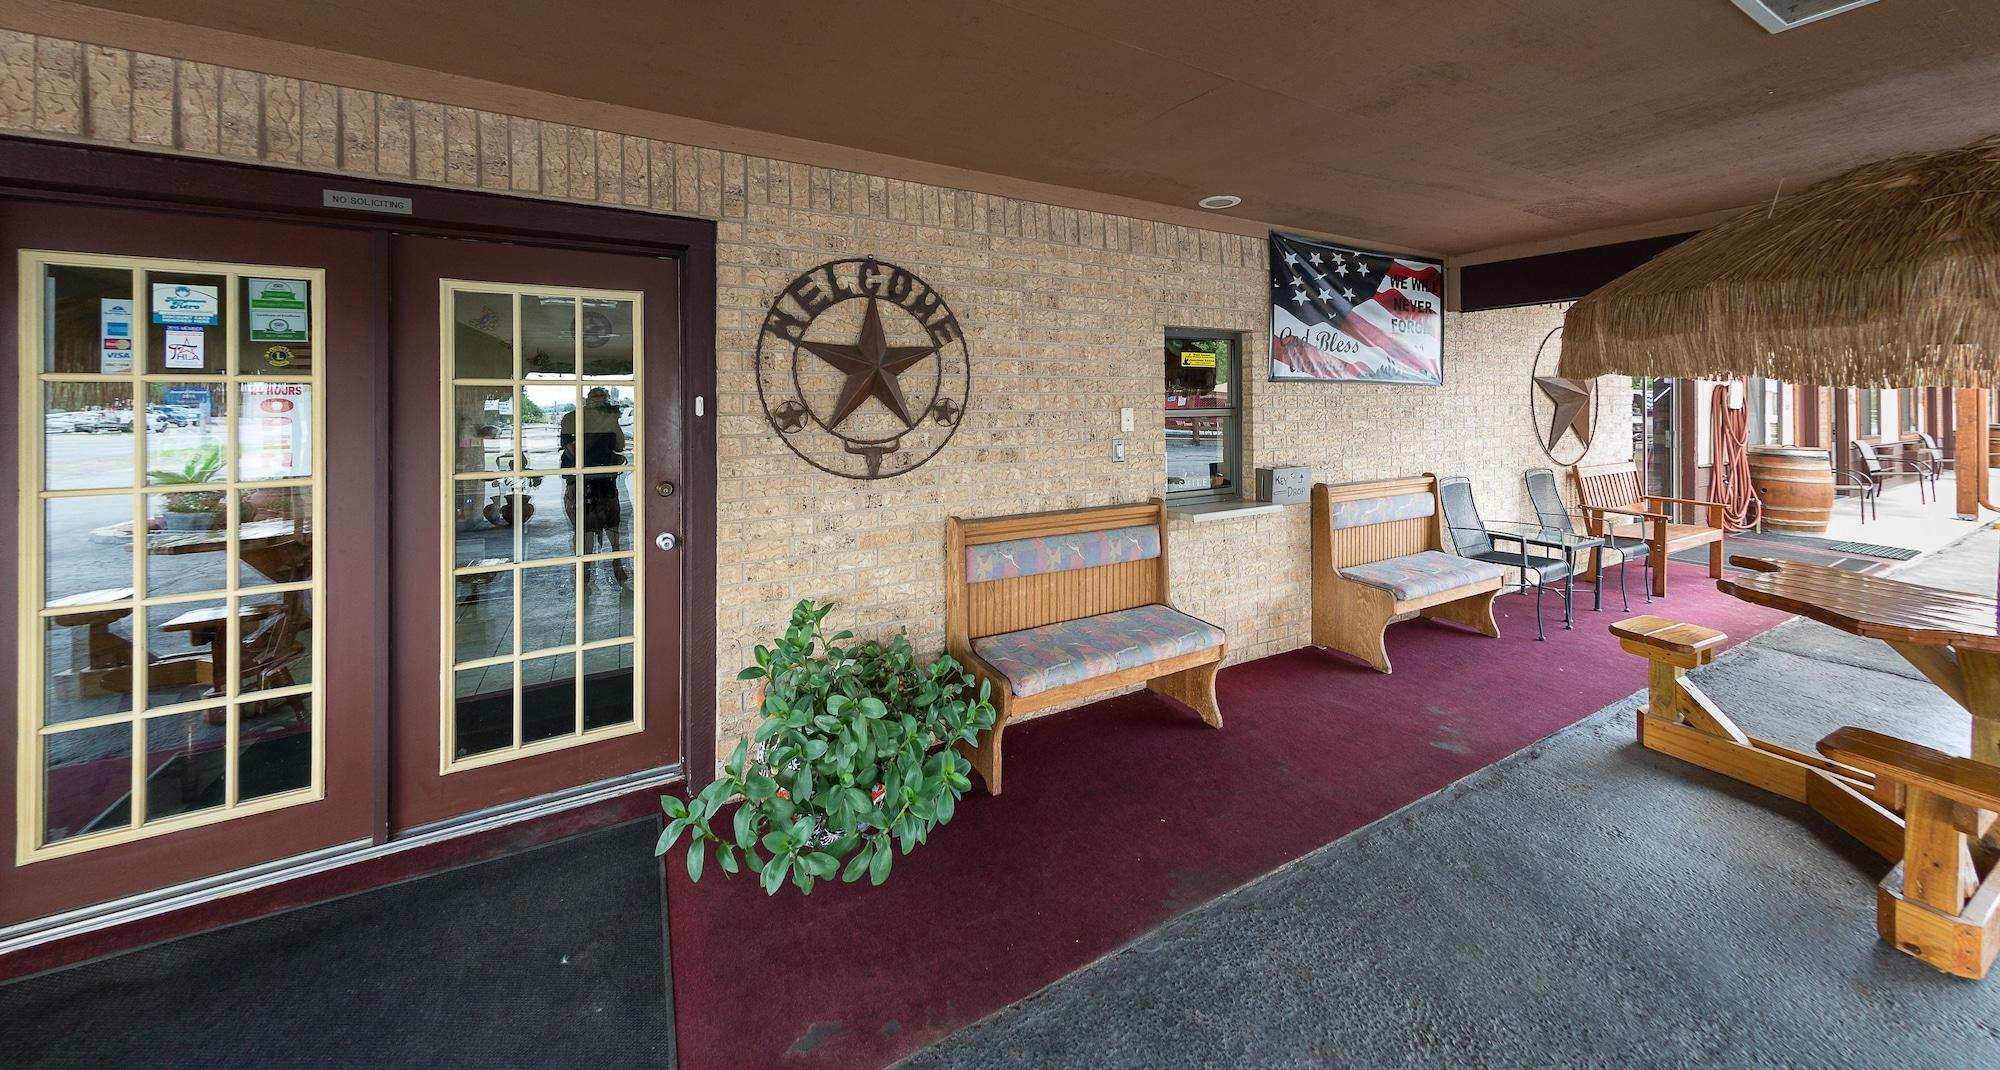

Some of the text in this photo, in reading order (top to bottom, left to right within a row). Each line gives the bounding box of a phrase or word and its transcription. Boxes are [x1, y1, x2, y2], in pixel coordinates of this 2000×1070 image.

[331, 195, 404, 210] NO SOLICITING
[1390, 275, 1408, 290] WE
[765, 260, 961, 347] WELCOME
[1392, 297, 1433, 314] NEVER
[1391, 318, 1432, 334] FORG
[1316, 330, 1360, 353] Bless
[266, 386, 303, 396] HOURS
[1275, 475, 1288, 486] KEY
[1287, 486, 1305, 498] DROP
